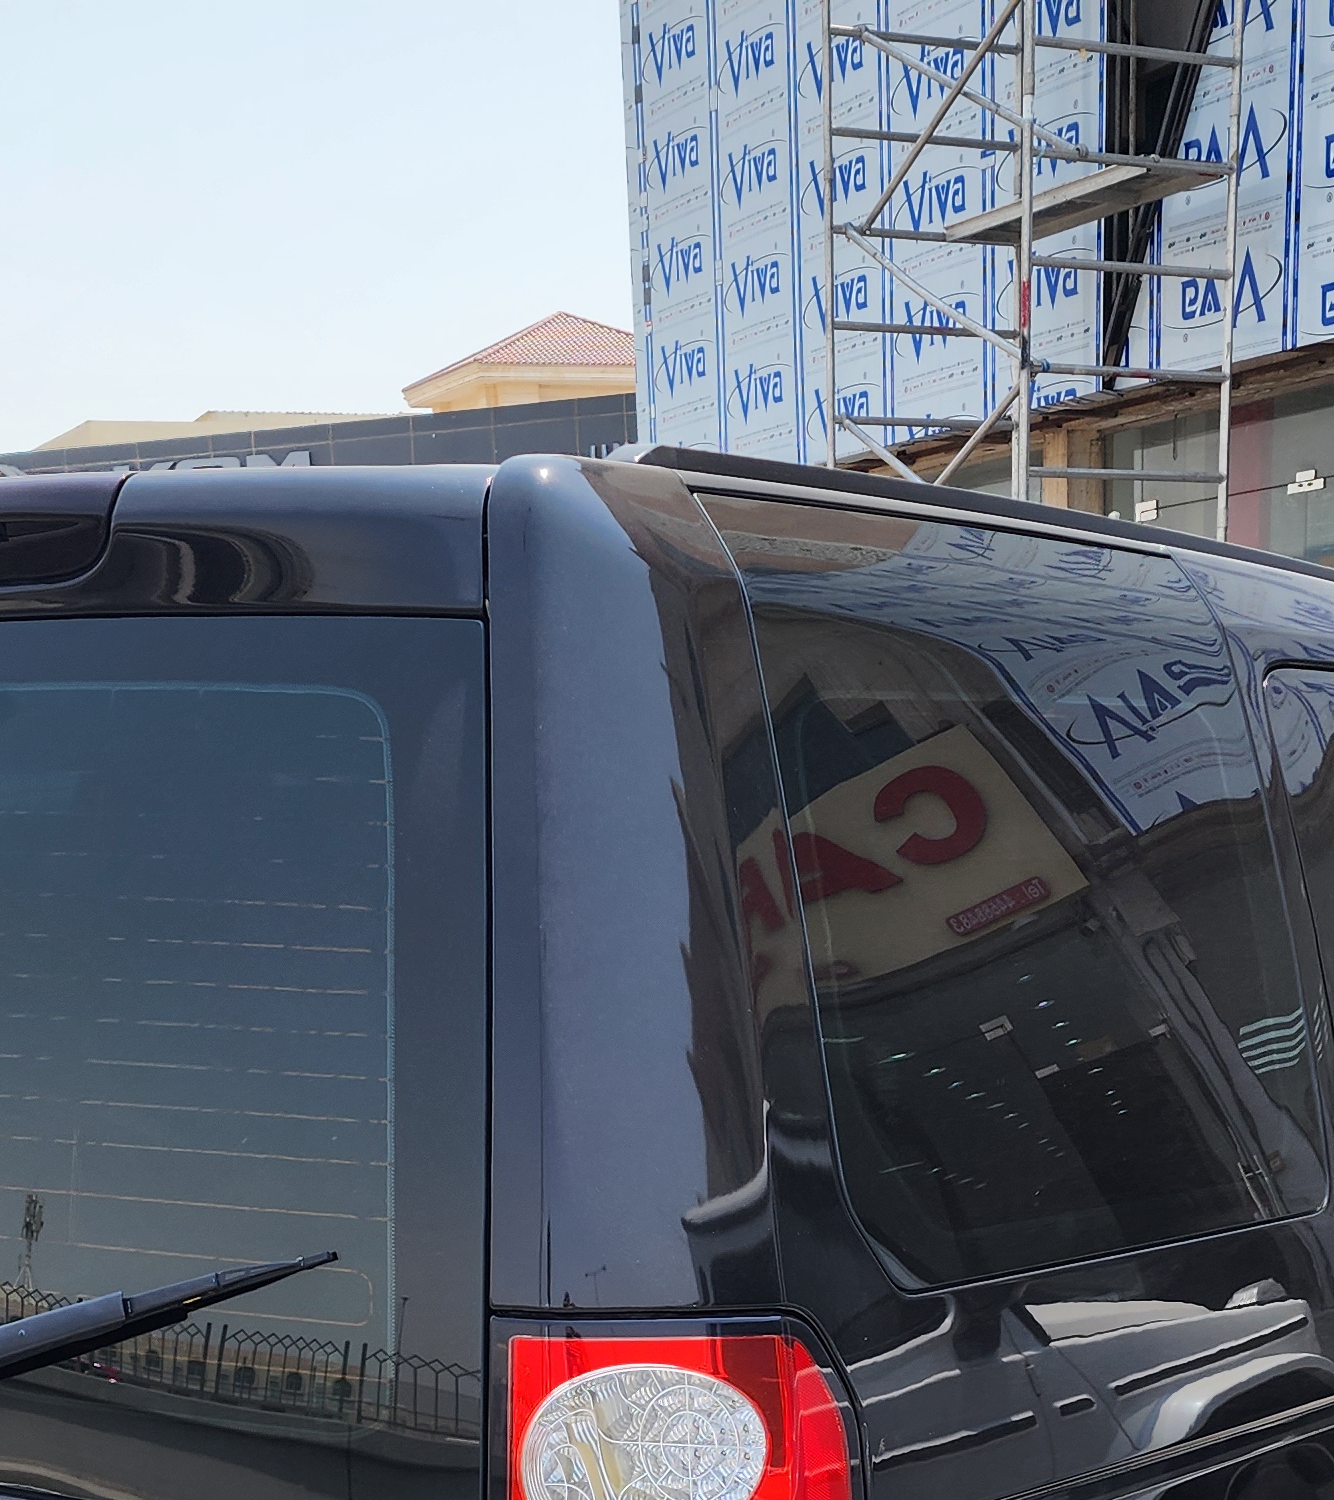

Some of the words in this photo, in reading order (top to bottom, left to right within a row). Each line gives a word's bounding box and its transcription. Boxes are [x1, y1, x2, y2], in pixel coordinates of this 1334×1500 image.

[648, 22, 696, 88] Viva
[725, 29, 775, 99] Viva
[653, 131, 699, 194] Viva
[728, 143, 777, 210] Viva
[903, 170, 966, 243] Viva
[657, 237, 703, 298] Viva
[731, 255, 781, 319] Viva
[661, 340, 707, 399] Viva
[734, 363, 783, 426] Viva
